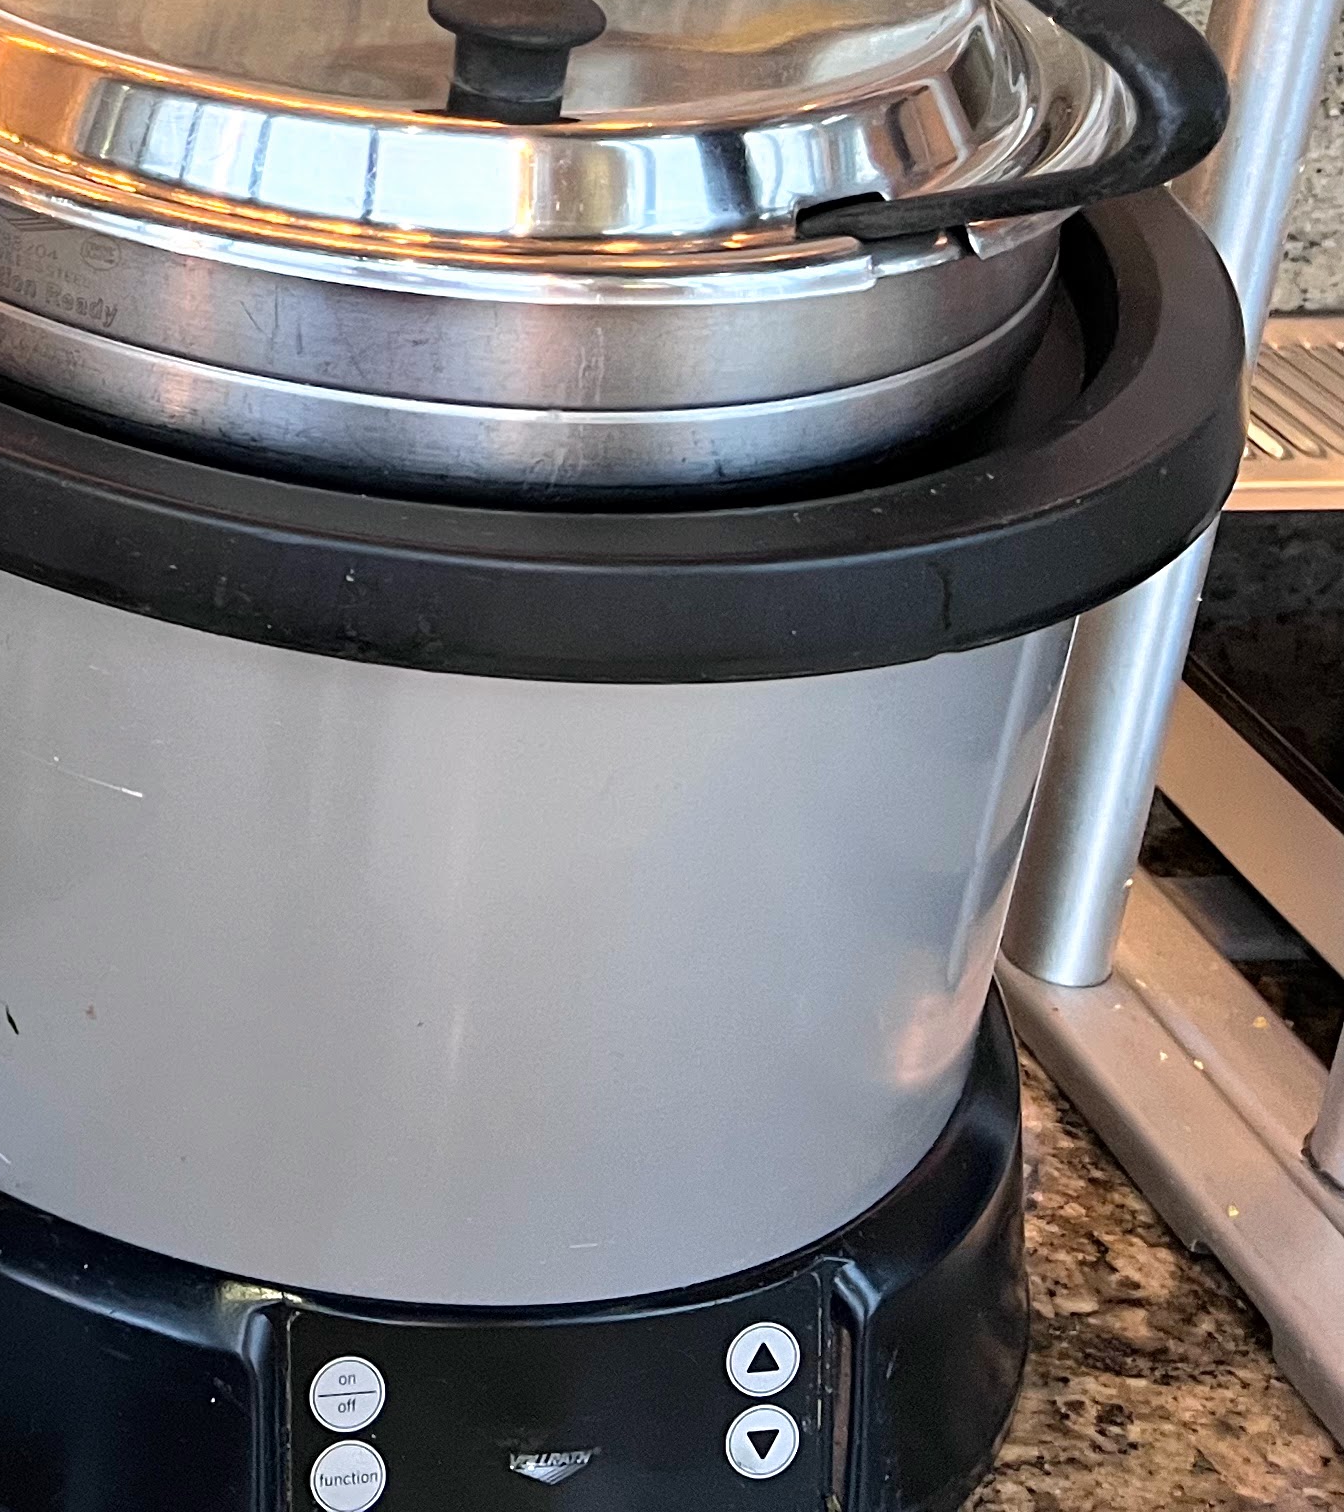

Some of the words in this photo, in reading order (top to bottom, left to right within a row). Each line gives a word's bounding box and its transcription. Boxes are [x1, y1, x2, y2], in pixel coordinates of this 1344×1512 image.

[44, 281, 119, 328] Ready
[338, 1372, 356, 1386] on
[337, 1398, 356, 1414] off
[319, 1469, 379, 1488] function
